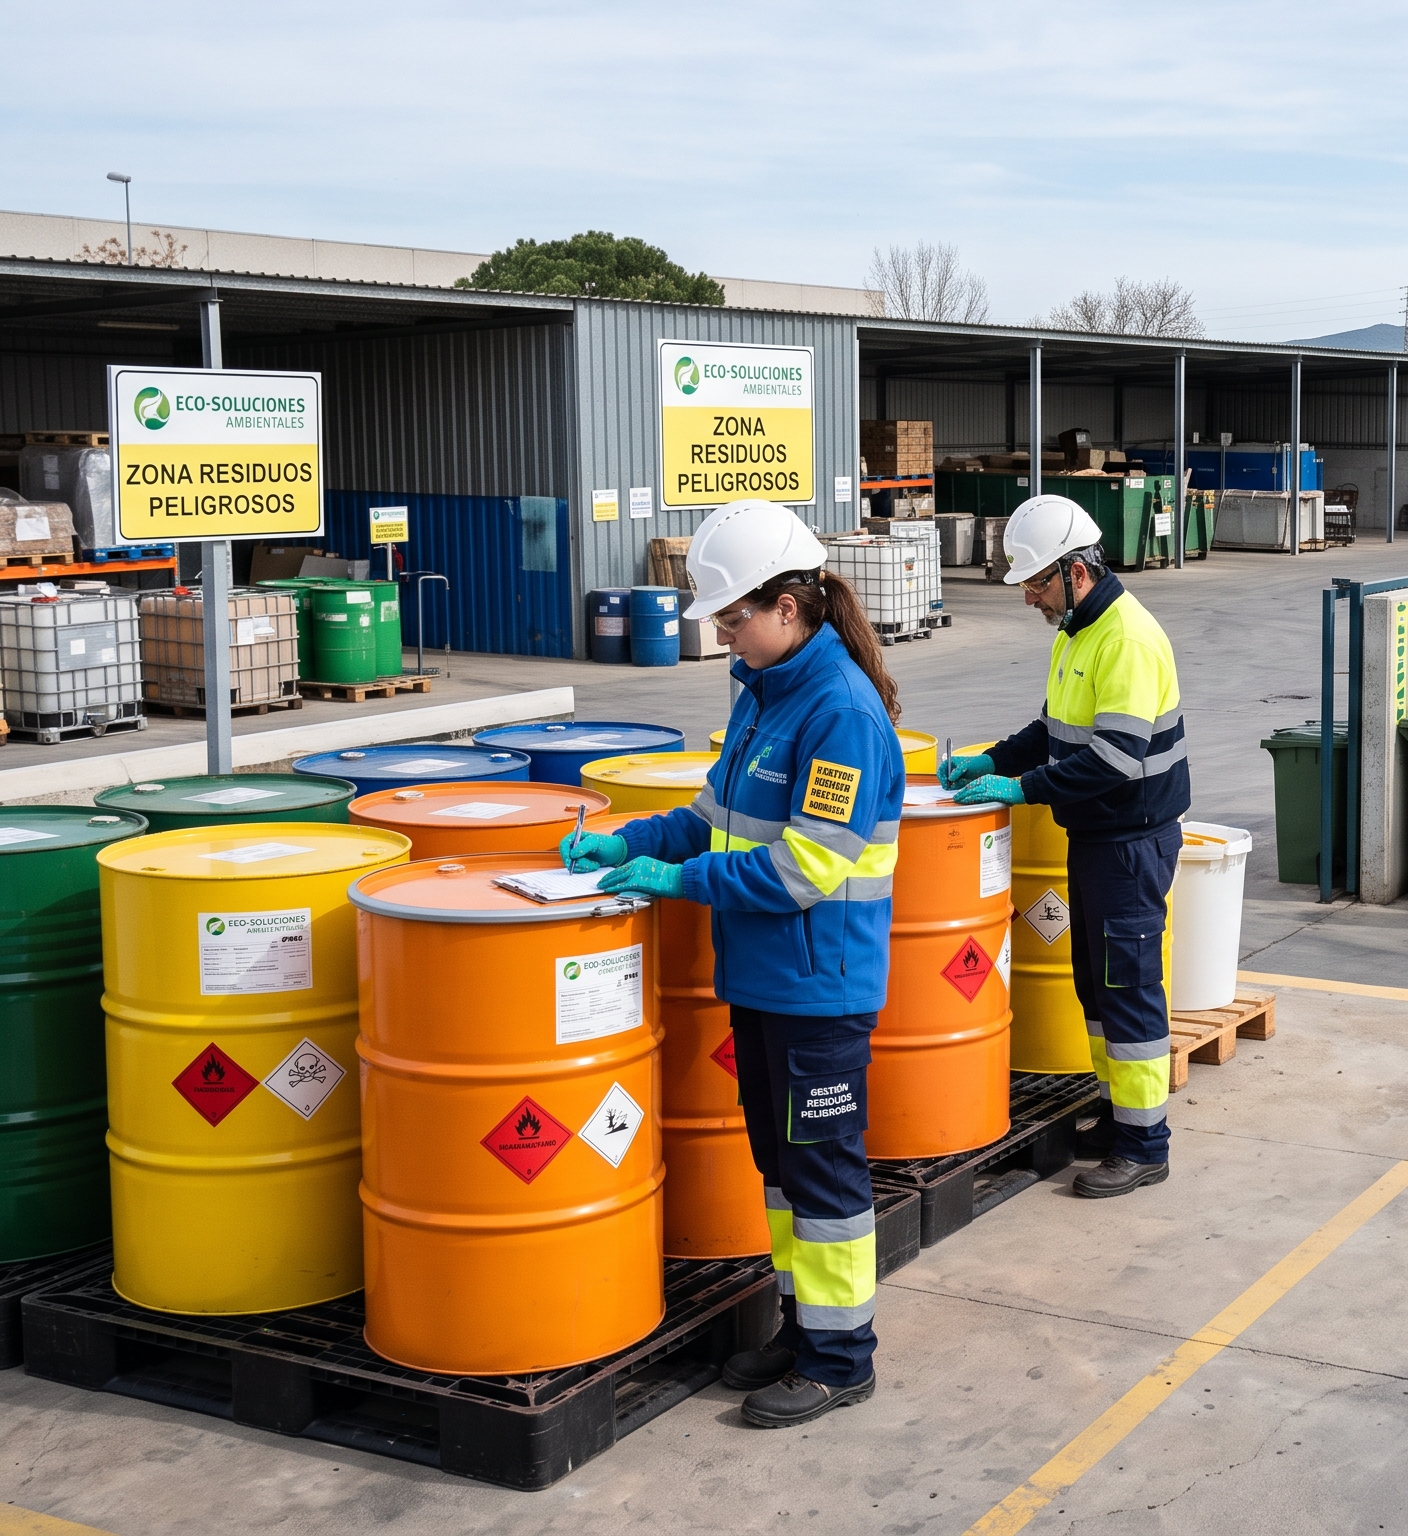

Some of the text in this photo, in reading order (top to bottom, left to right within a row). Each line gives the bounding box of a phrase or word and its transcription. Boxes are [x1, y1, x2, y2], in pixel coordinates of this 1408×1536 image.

[704, 364, 803, 381] ECO-SOLUCIONES
[743, 384, 802, 396] AMBIENTALES
[176, 395, 305, 413] ECO-SOLUCIONES
[226, 416, 305, 429] AMBIENTALES
[713, 416, 766, 436] ZONA
[691, 444, 787, 464] RESIDUOS
[126, 462, 312, 485] ZONA RESIDUOS
[678, 471, 799, 493] PELIGROSOS
[150, 493, 295, 517] PELIGROSOS
[810, 1083, 849, 1096] GESTIÓN
[806, 1093, 852, 1108] RESIDUOS
